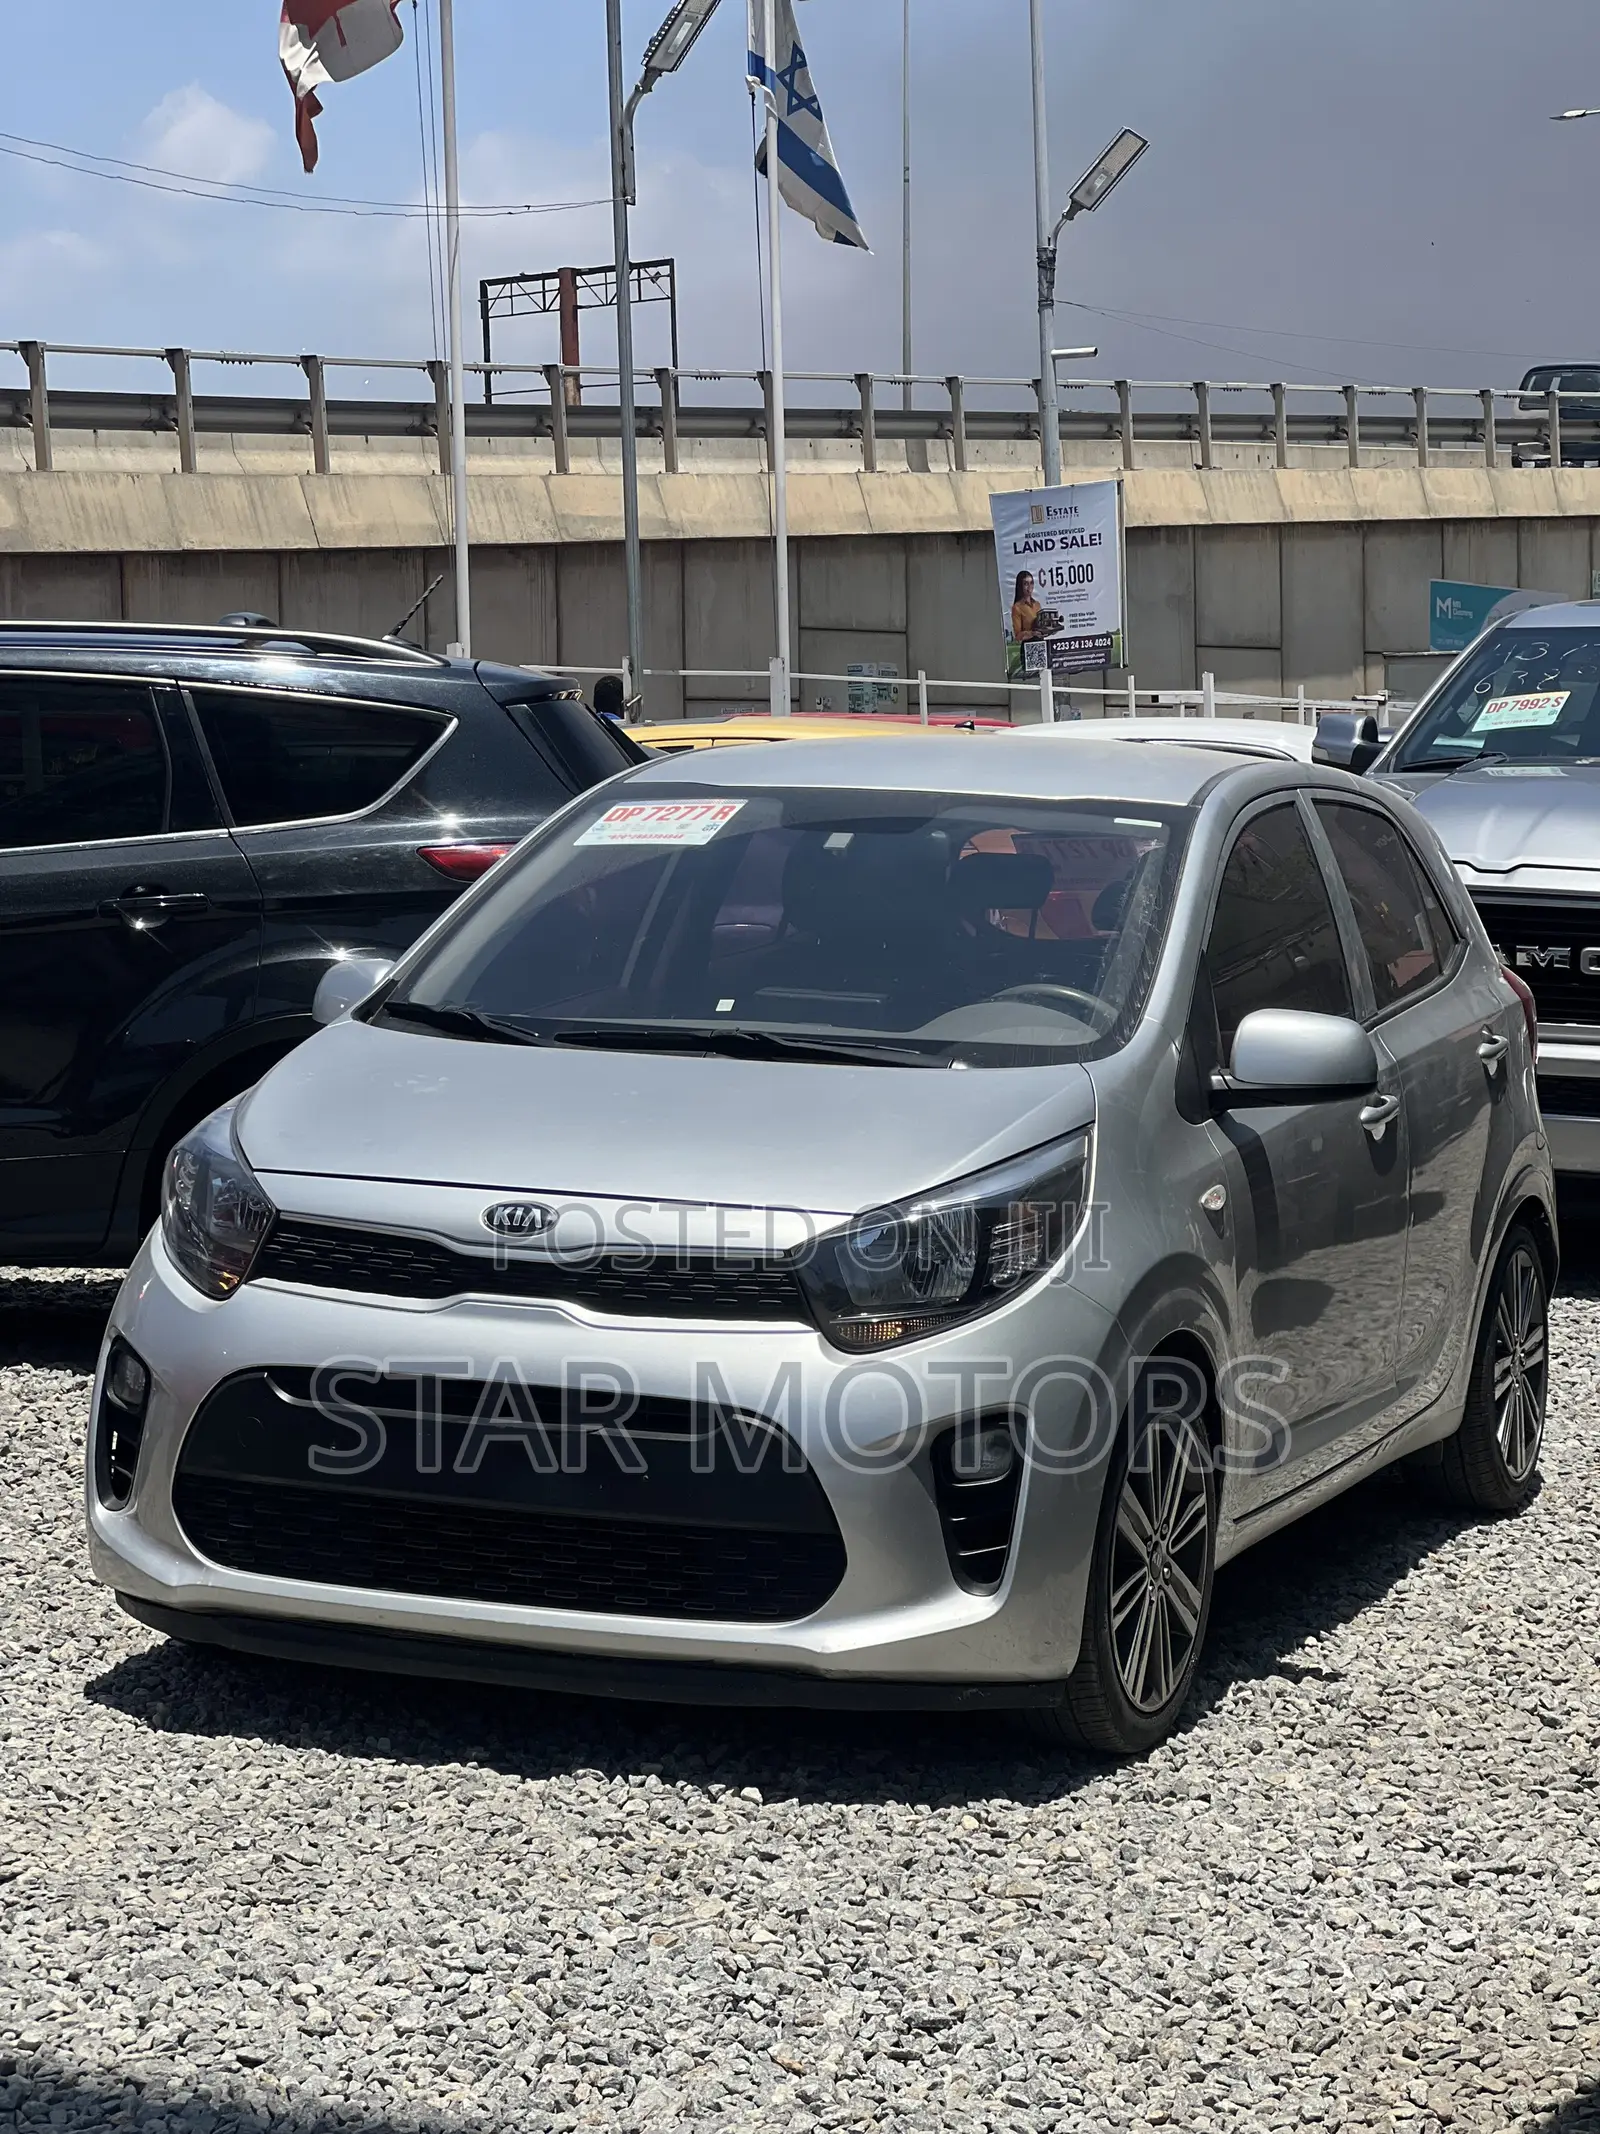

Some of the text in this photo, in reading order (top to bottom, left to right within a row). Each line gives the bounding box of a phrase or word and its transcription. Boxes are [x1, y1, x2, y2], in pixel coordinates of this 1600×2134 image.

[1046, 506, 1079, 517] ESTATE
[1024, 527, 1085, 539] REGISTERED SERVICED
[1013, 533, 1102, 555] LAND SALE!
[1052, 638, 1111, 650] +233 24 136 4024
[1485, 701, 1509, 715] DP
[1509, 697, 1551, 713] 7992
[1551, 696, 1564, 708] S
[604, 805, 737, 822] DP 7277 R
[493, 1206, 542, 1229] KIA
